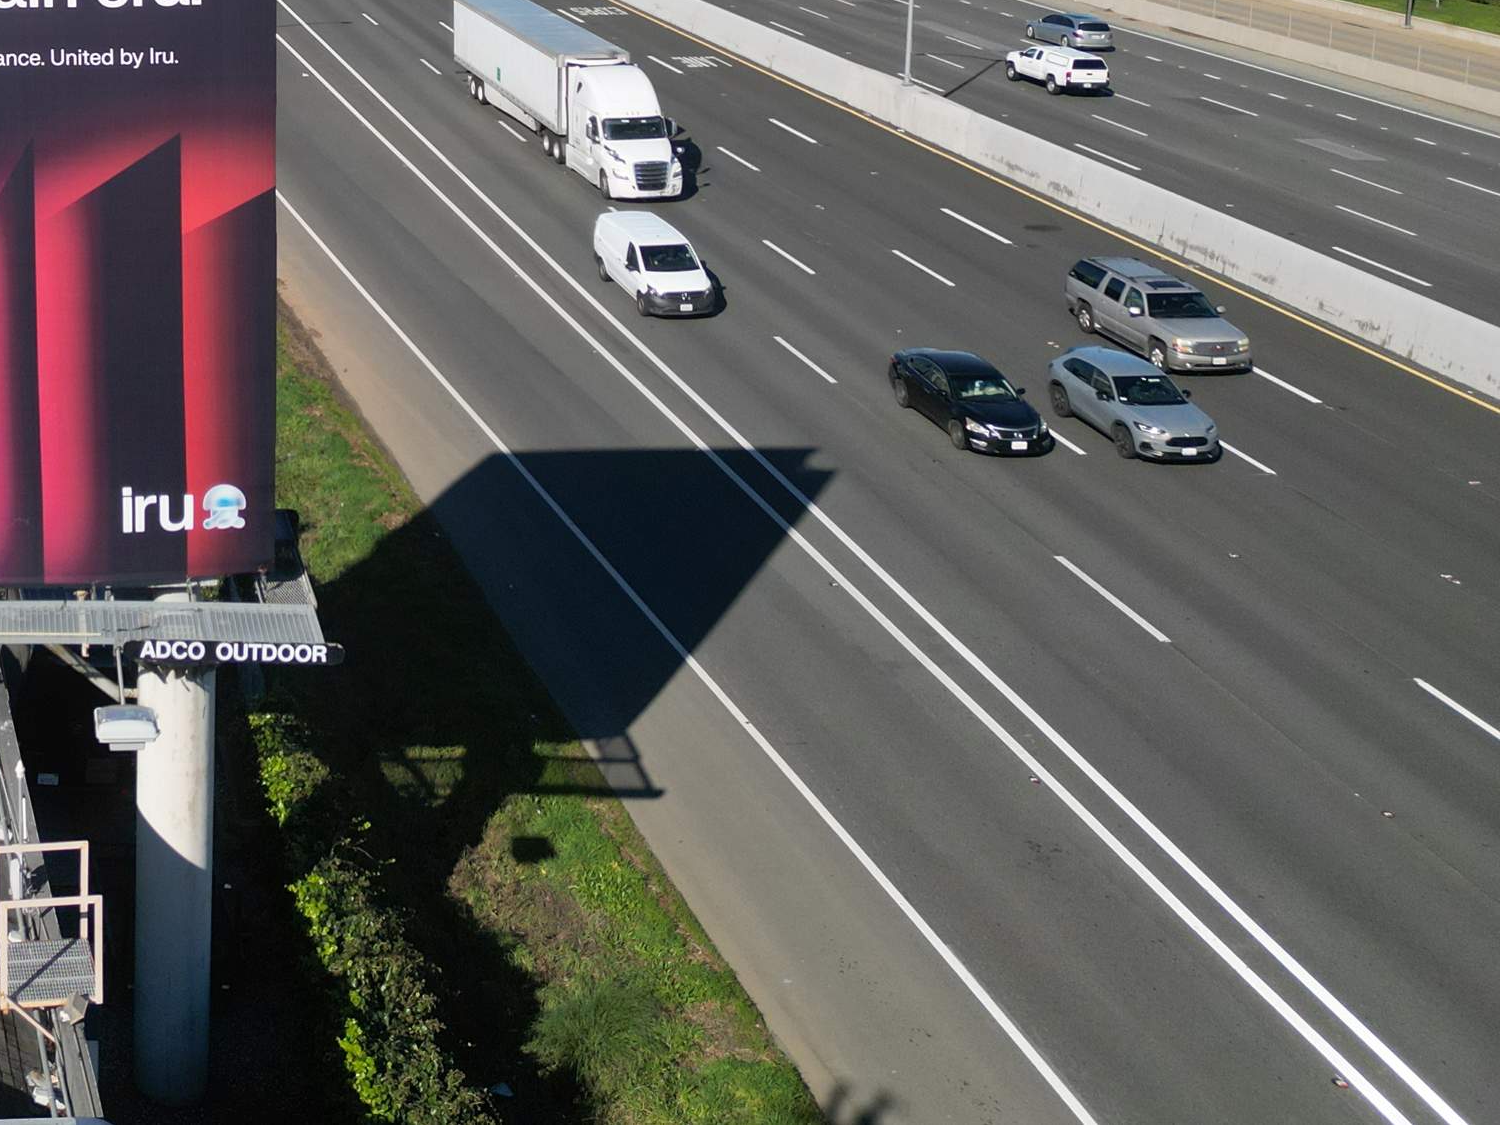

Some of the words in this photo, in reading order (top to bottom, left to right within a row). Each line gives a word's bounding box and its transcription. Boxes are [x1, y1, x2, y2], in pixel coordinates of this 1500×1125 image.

[50, 48, 114, 66] United
[120, 47, 144, 69] by
[149, 47, 179, 65] Iru.
[122, 486, 194, 533] iru
[139, 641, 206, 661] ADCO
[215, 641, 329, 663] OUTDOOR
